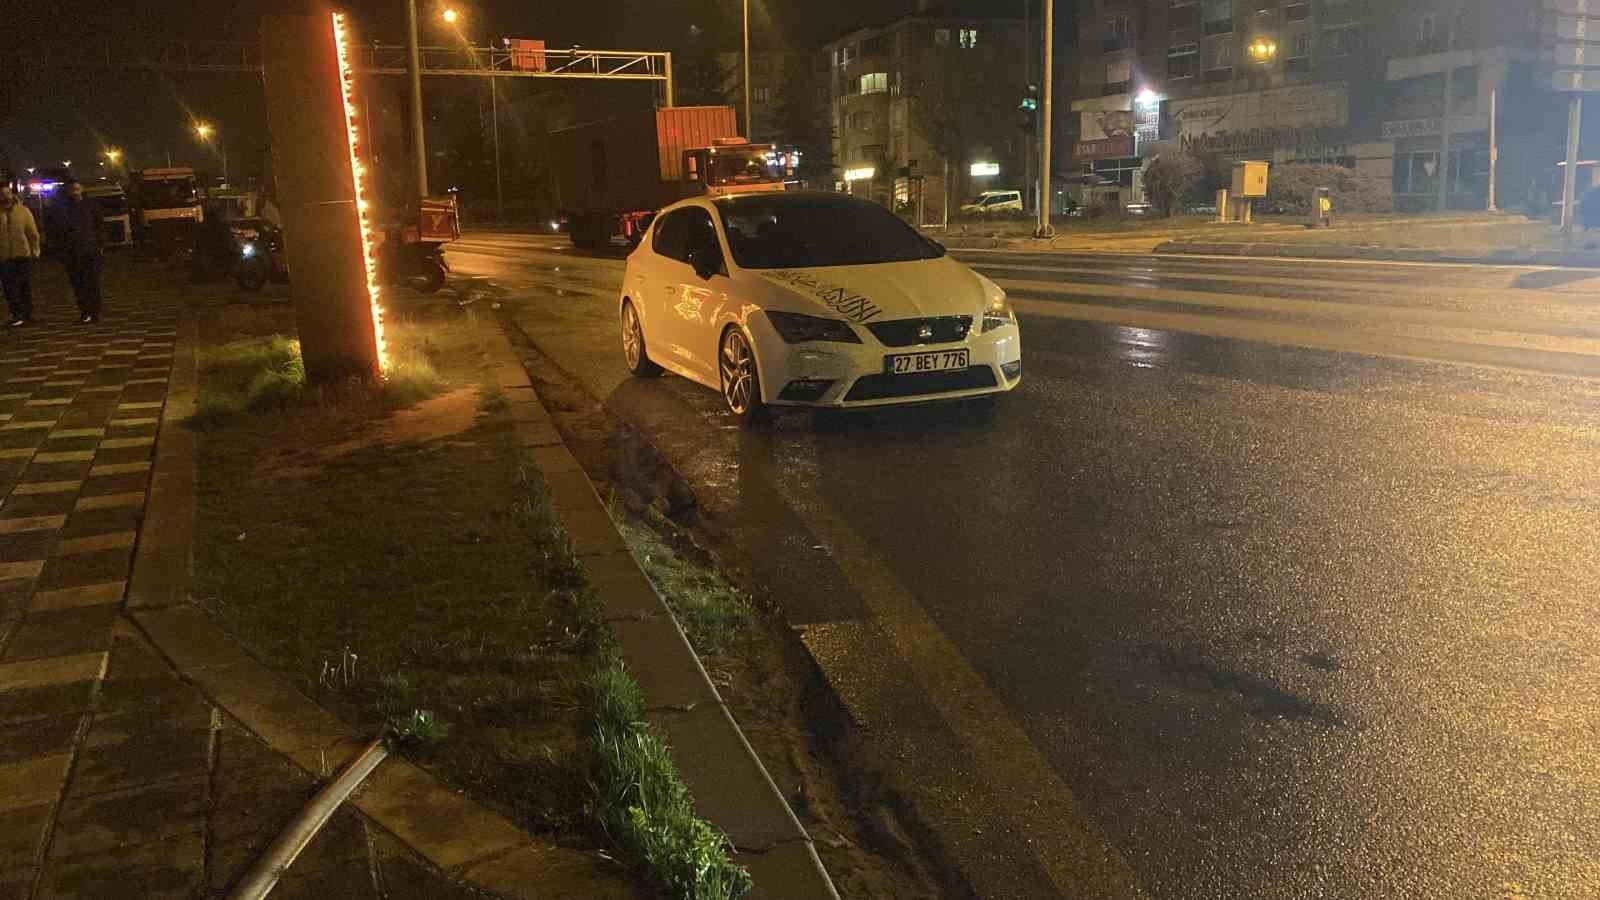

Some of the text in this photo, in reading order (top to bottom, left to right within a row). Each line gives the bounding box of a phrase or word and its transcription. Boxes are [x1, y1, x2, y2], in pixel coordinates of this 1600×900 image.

[895, 351, 966, 372] 27 BEY 776
